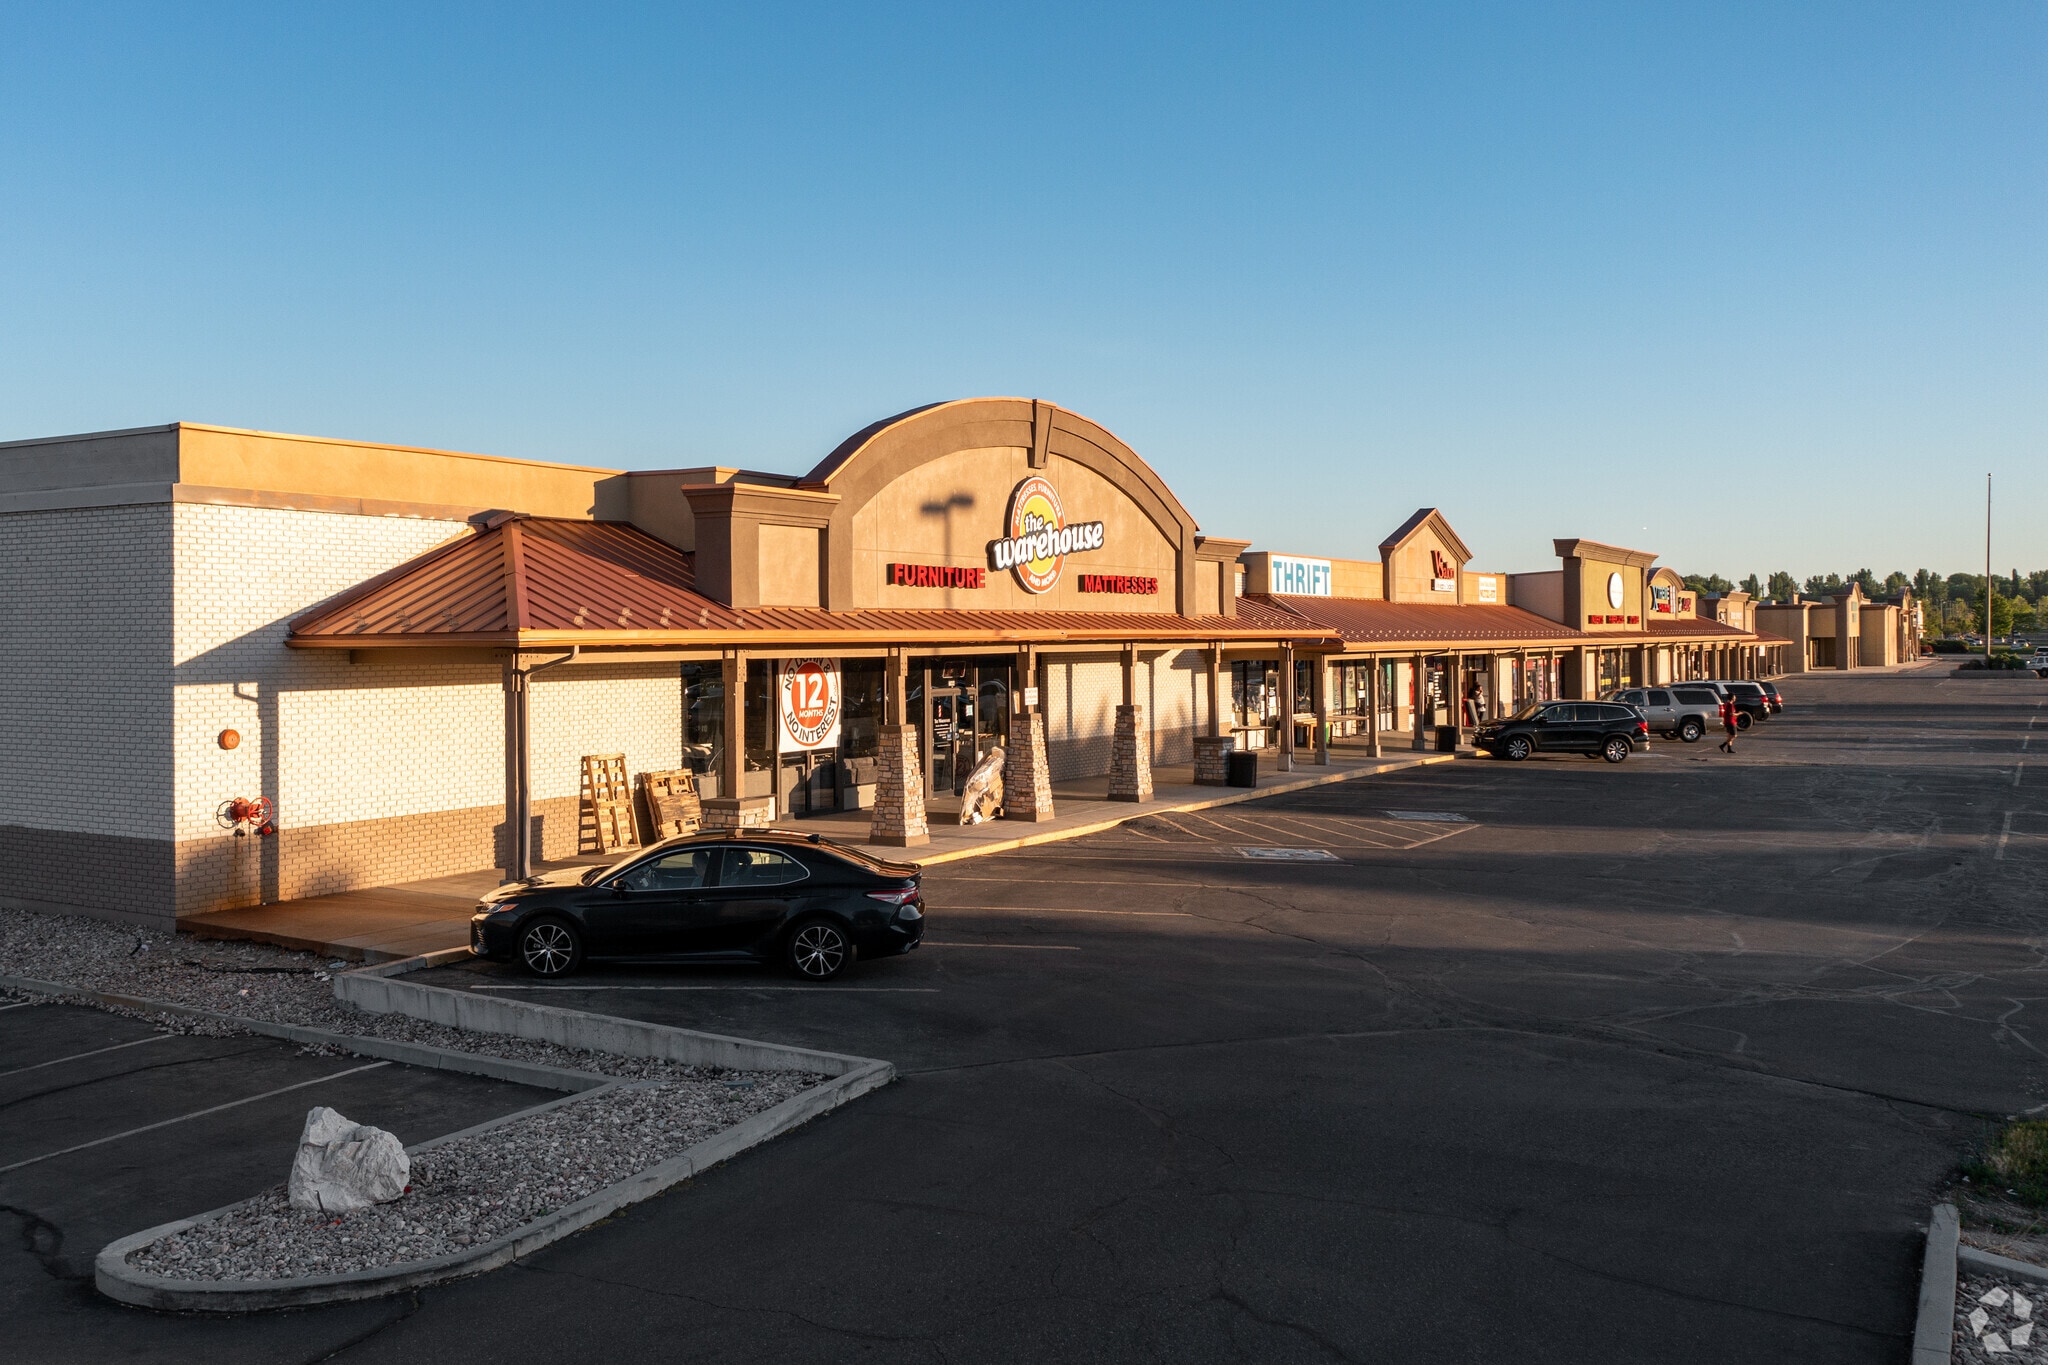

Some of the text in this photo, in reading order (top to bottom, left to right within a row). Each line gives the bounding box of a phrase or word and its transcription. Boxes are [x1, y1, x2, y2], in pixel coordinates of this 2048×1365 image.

[1038, 483, 1062, 518] FURNITURE
[1025, 512, 1044, 533] the
[994, 523, 1103, 569] warehouse
[894, 563, 985, 588] FURNITURE
[1029, 574, 1041, 587] AND
[1084, 574, 1158, 594] MATTRESSES
[1273, 561, 1330, 595] THRIFT
[785, 668, 796, 690] NO
[823, 663, 831, 675] &
[796, 673, 823, 709] 12
[787, 697, 837, 742] NO INTEREST
[799, 709, 823, 718] MONTHS
